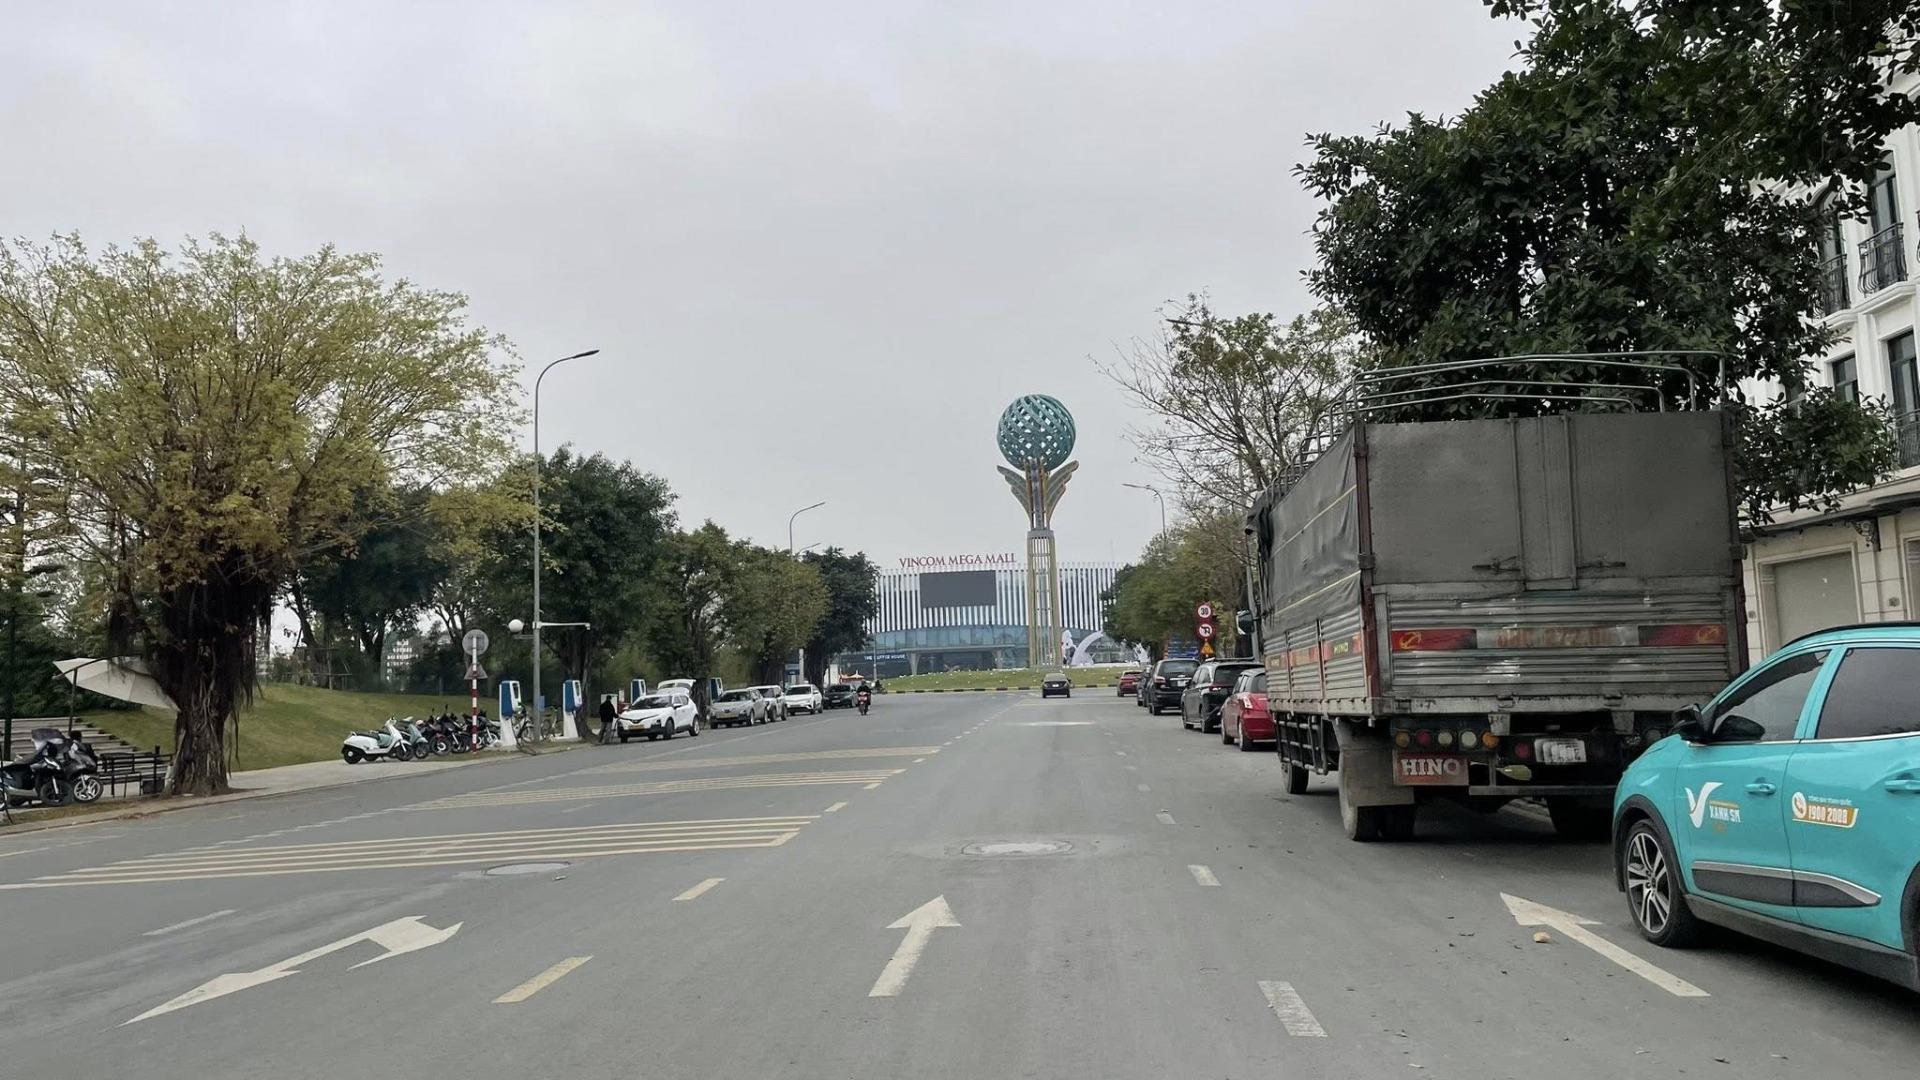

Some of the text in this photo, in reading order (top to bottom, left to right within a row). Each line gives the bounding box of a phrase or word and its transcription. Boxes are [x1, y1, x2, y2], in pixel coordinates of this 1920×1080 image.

[899, 553, 1016, 568] VINCOM MEGA MALL
[1200, 607, 1210, 616] 30
[1400, 758, 1461, 776] HINO
[1709, 805, 1741, 823] XANH SM
[1808, 804, 1827, 821] 1900
